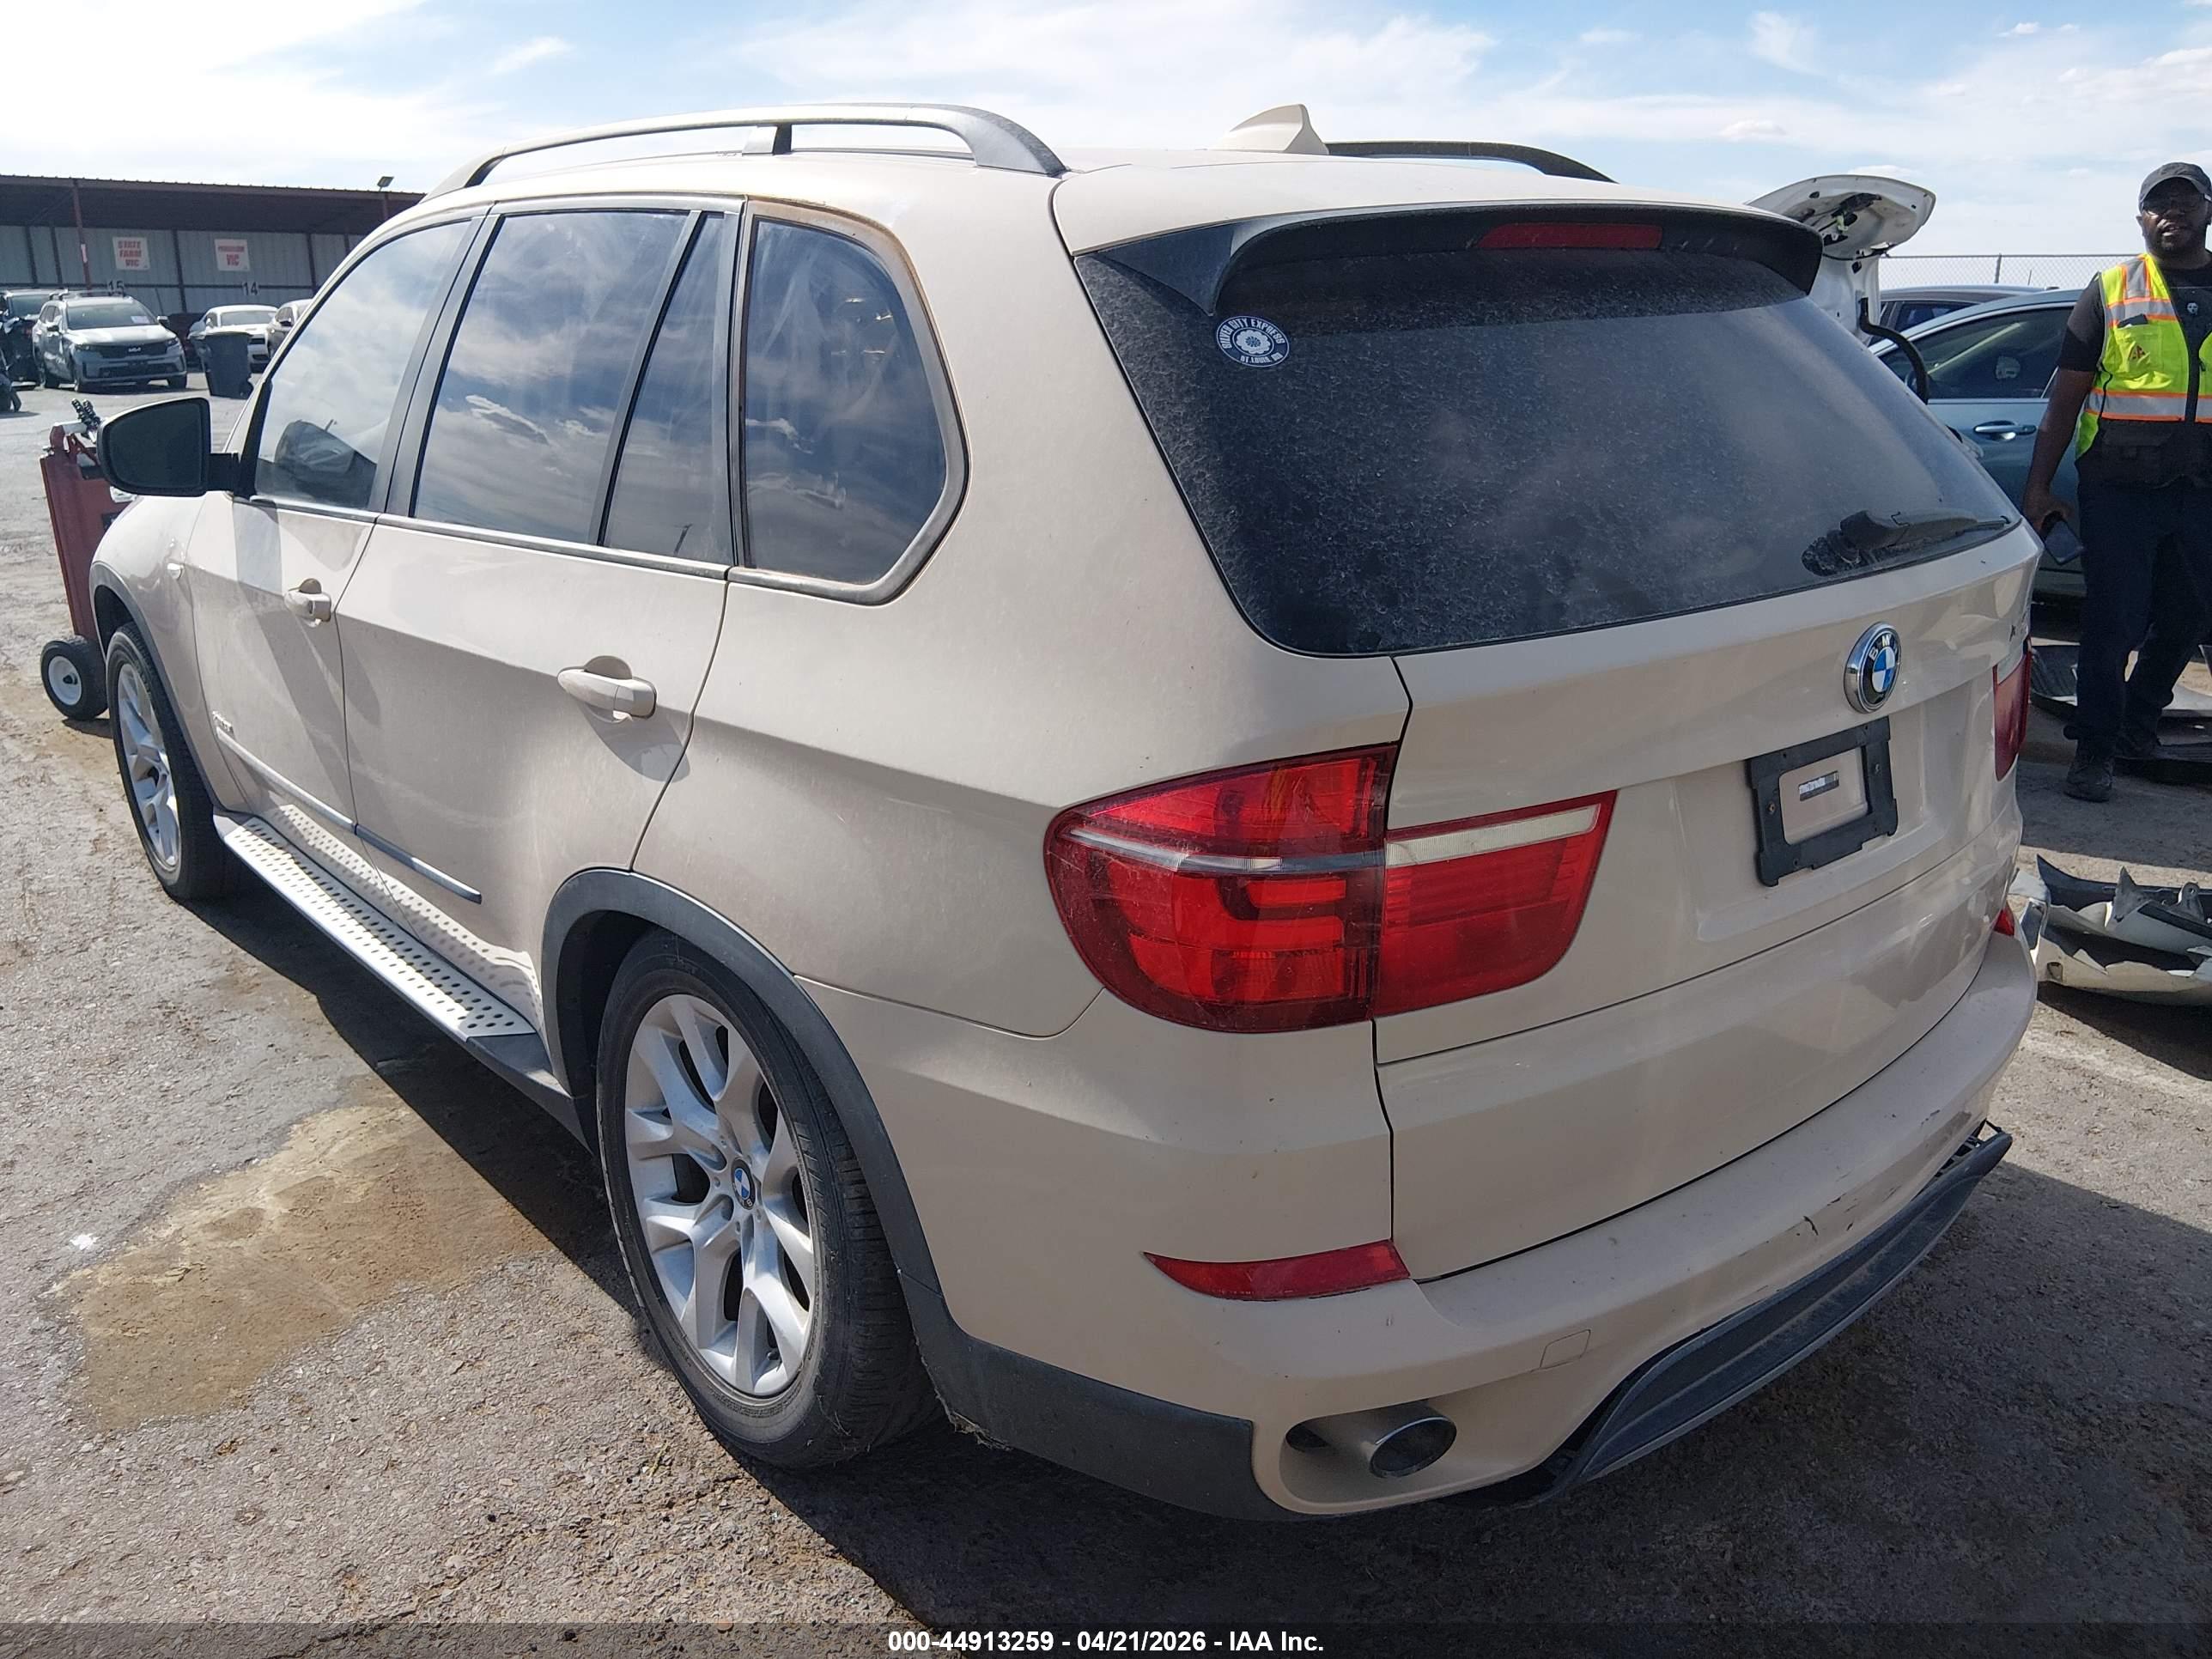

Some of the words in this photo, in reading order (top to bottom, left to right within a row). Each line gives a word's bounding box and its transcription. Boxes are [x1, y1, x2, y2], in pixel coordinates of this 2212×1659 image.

[242, 281, 258, 295] 14
[1227, 318, 1249, 329] CITY
[1250, 319, 1285, 344] EXPRESS
